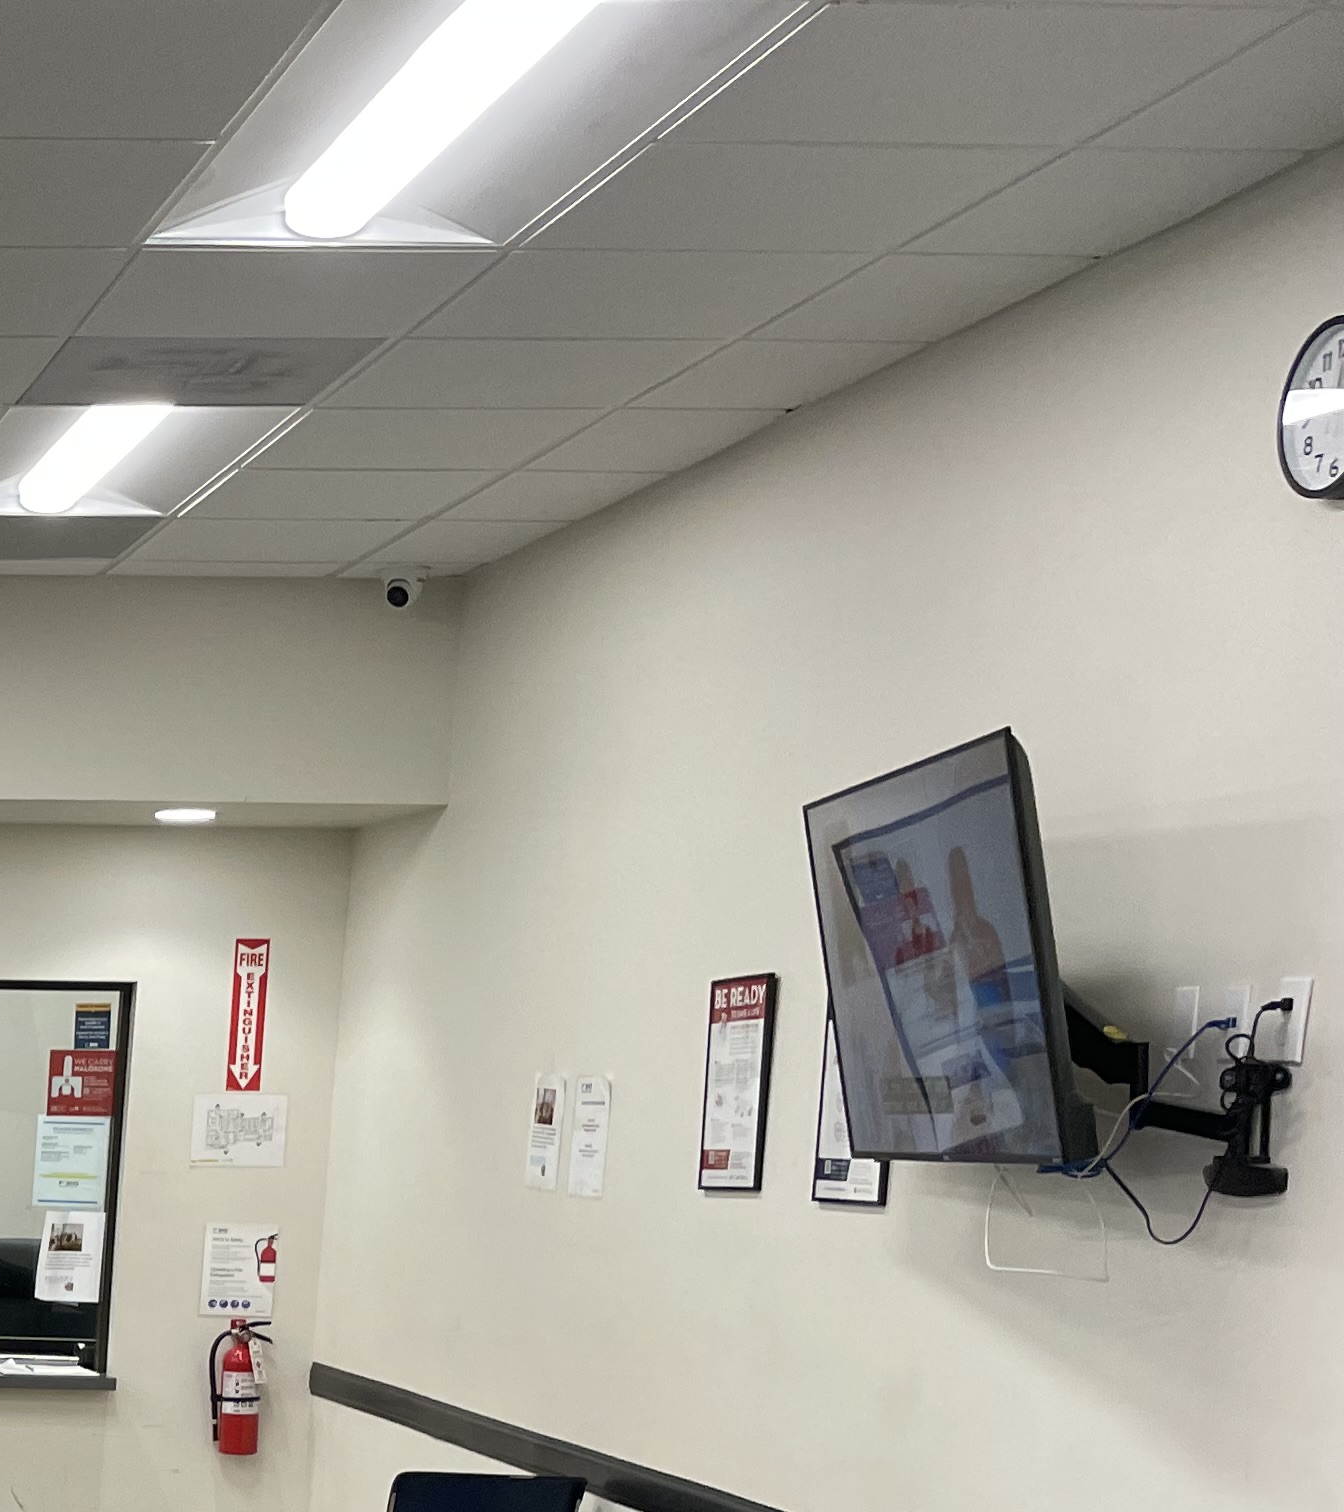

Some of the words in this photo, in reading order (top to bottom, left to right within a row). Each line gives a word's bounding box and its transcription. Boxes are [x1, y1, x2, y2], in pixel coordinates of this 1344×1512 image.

[1303, 435, 1313, 456] 8
[1314, 453, 1324, 473] 7
[1328, 458, 1339, 478] 6
[239, 953, 264, 966] FIRE
[714, 989, 728, 1010] BE
[730, 983, 766, 1008] READY
[239, 972, 254, 1080] EXTINGUISHER
